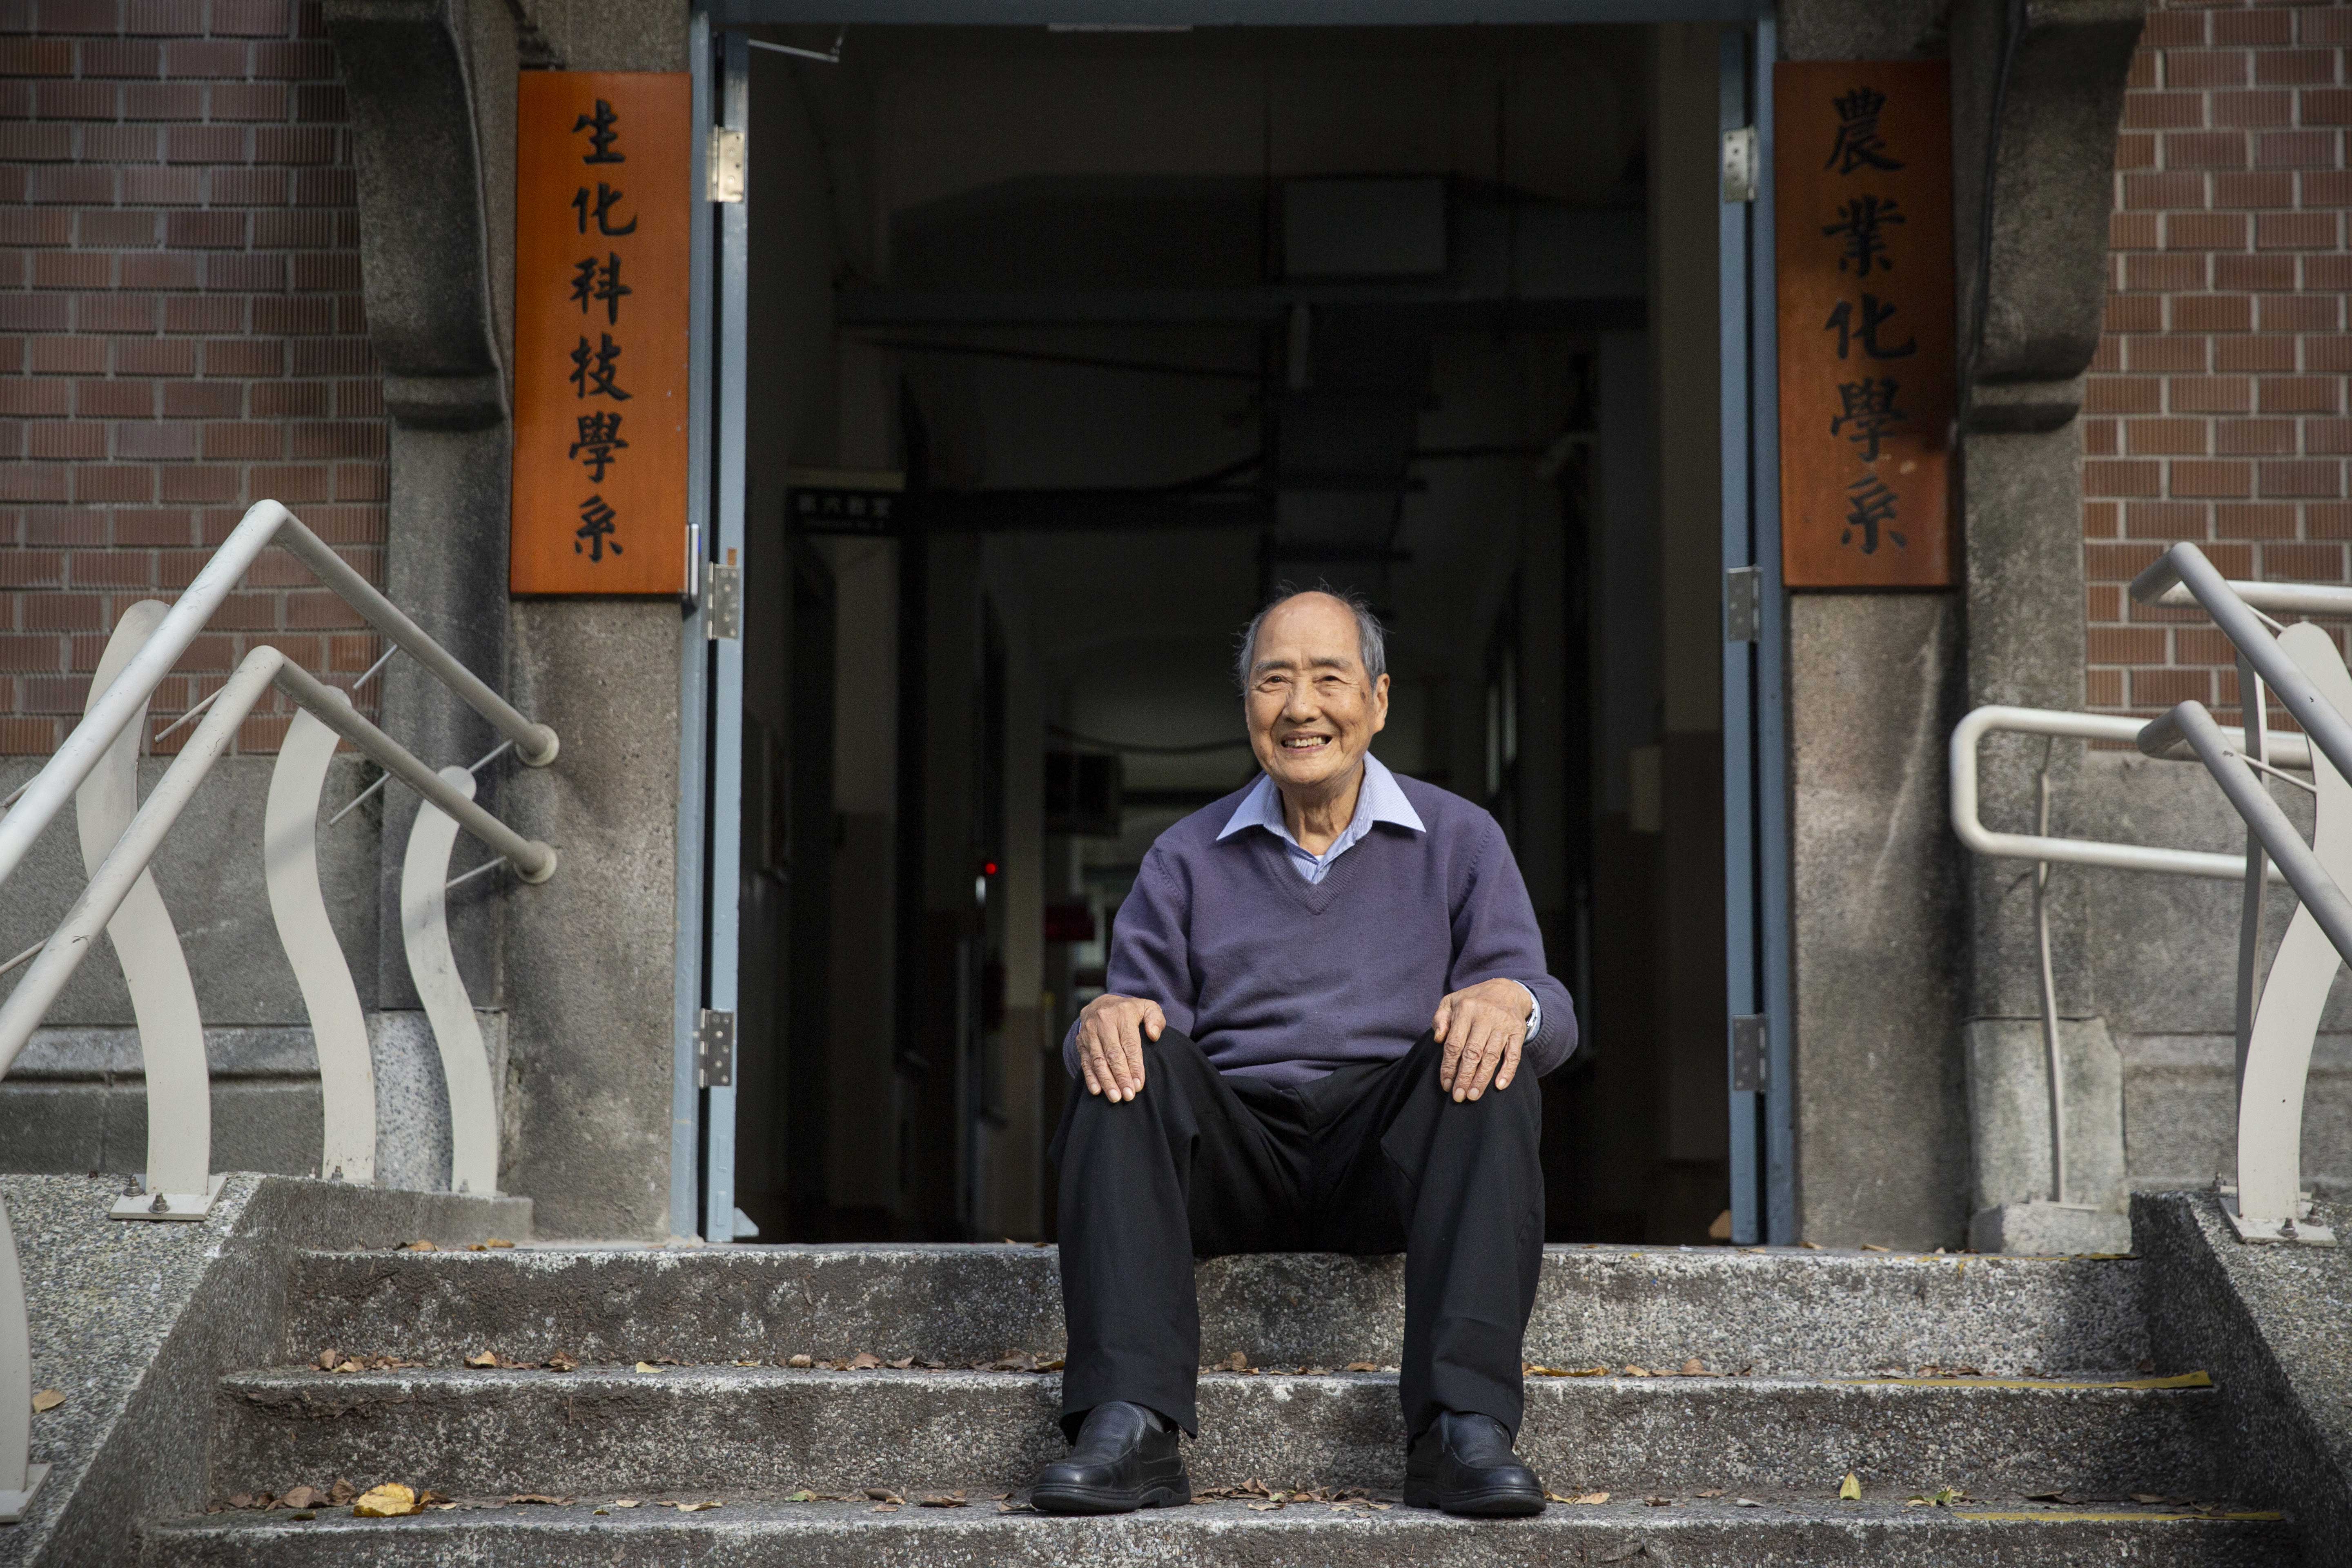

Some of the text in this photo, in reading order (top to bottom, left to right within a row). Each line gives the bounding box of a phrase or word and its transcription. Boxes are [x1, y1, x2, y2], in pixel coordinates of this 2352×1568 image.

[569, 100, 637, 562] 生化科技學系
[1823, 88, 1917, 554] 農業化學系
